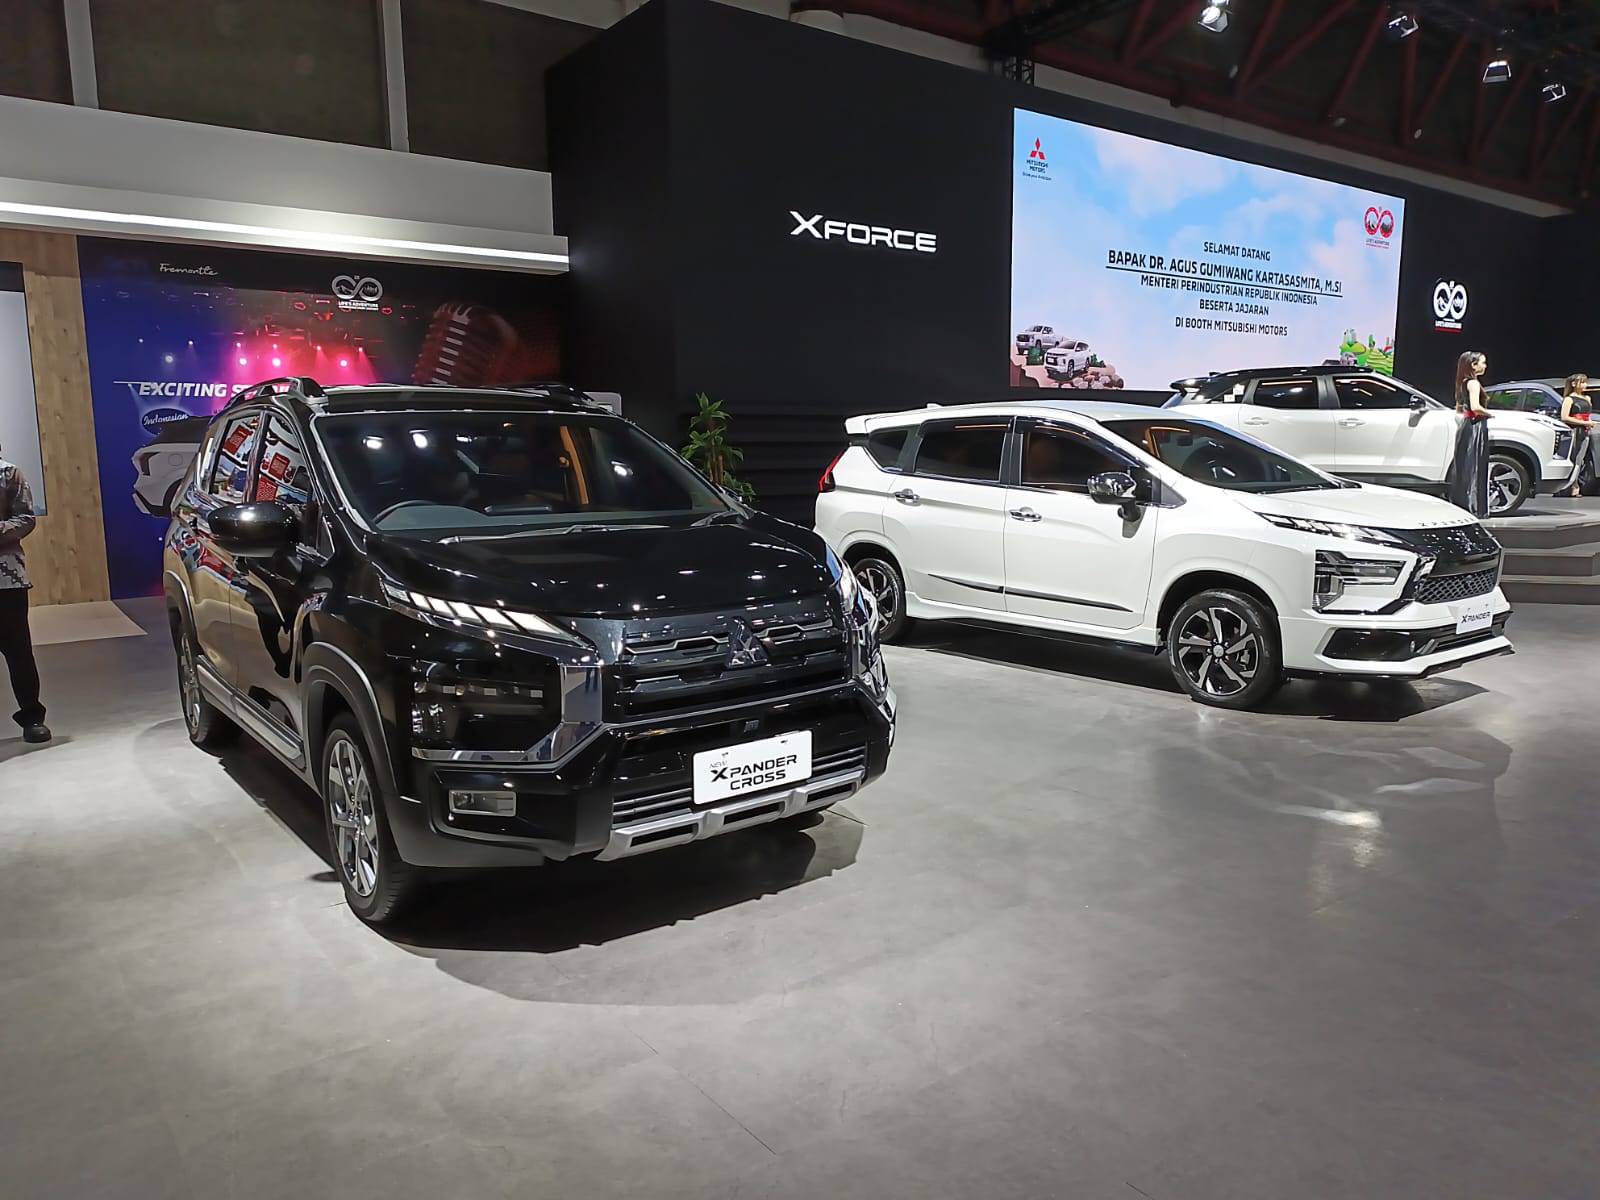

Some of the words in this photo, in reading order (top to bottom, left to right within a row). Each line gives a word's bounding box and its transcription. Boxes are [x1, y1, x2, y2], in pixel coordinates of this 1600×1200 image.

[789, 210, 936, 252] XFORCE
[1203, 241, 1240, 257] SELAMAT
[1241, 246, 1271, 261] DATANG
[1108, 249, 1147, 269] BAPAK
[1149, 255, 1167, 271] DR.
[1169, 258, 1198, 275] AGUS
[1200, 262, 1254, 281] GUMIWANG
[1255, 269, 1323, 293] KARTASASMITA,
[1324, 279, 1342, 294] M.SI
[1140, 274, 1179, 290] MENTERI
[1180, 279, 1244, 297] PERINDUSTRIAN
[1245, 287, 1280, 302] REPUBLIK
[1281, 292, 1318, 306] INDONESIA
[1199, 298, 1234, 313] BESERTA
[1235, 302, 1269, 316] JAJARAN
[1175, 316, 1184, 327] DI
[1185, 317, 1212, 330] BOOTH
[1213, 320, 1257, 334] MITSUBISHI
[1258, 324, 1288, 337] MOTORS
[139, 382, 228, 398] EXCITING
[143, 411, 189, 426] Indonesian
[710, 754, 798, 783] XPANDER
[730, 769, 786, 790] CROSS
